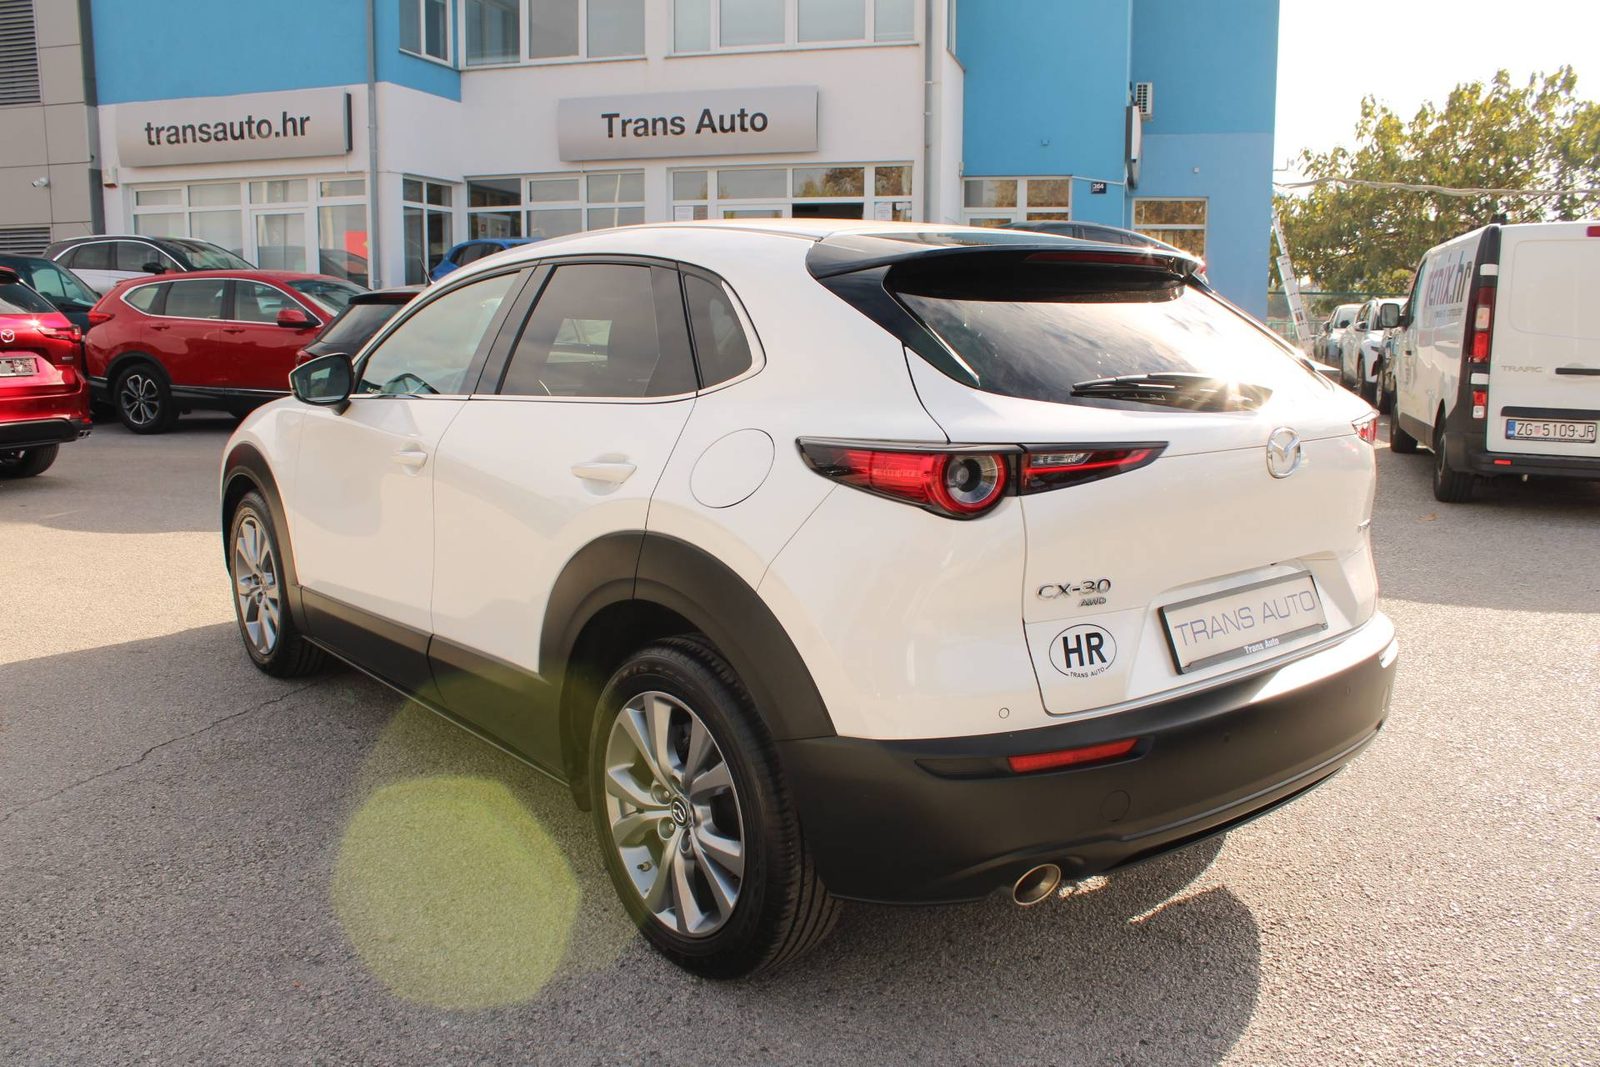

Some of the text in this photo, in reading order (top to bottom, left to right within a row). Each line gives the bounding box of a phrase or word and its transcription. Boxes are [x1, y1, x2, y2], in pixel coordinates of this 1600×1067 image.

[144, 111, 311, 146] transauto.hr
[601, 108, 769, 138] Trans Auto
[1501, 365, 1544, 373] TRAFIC
[1516, 422, 1533, 436] ZG
[1037, 578, 1111, 599] CX-30
[1078, 597, 1106, 607] AWD
[1174, 590, 1316, 646] TRANS AUTO
[1062, 632, 1107, 669] HR
[1244, 638, 1280, 654] Trans Auto
[1090, 667, 1105, 676] AUTO
